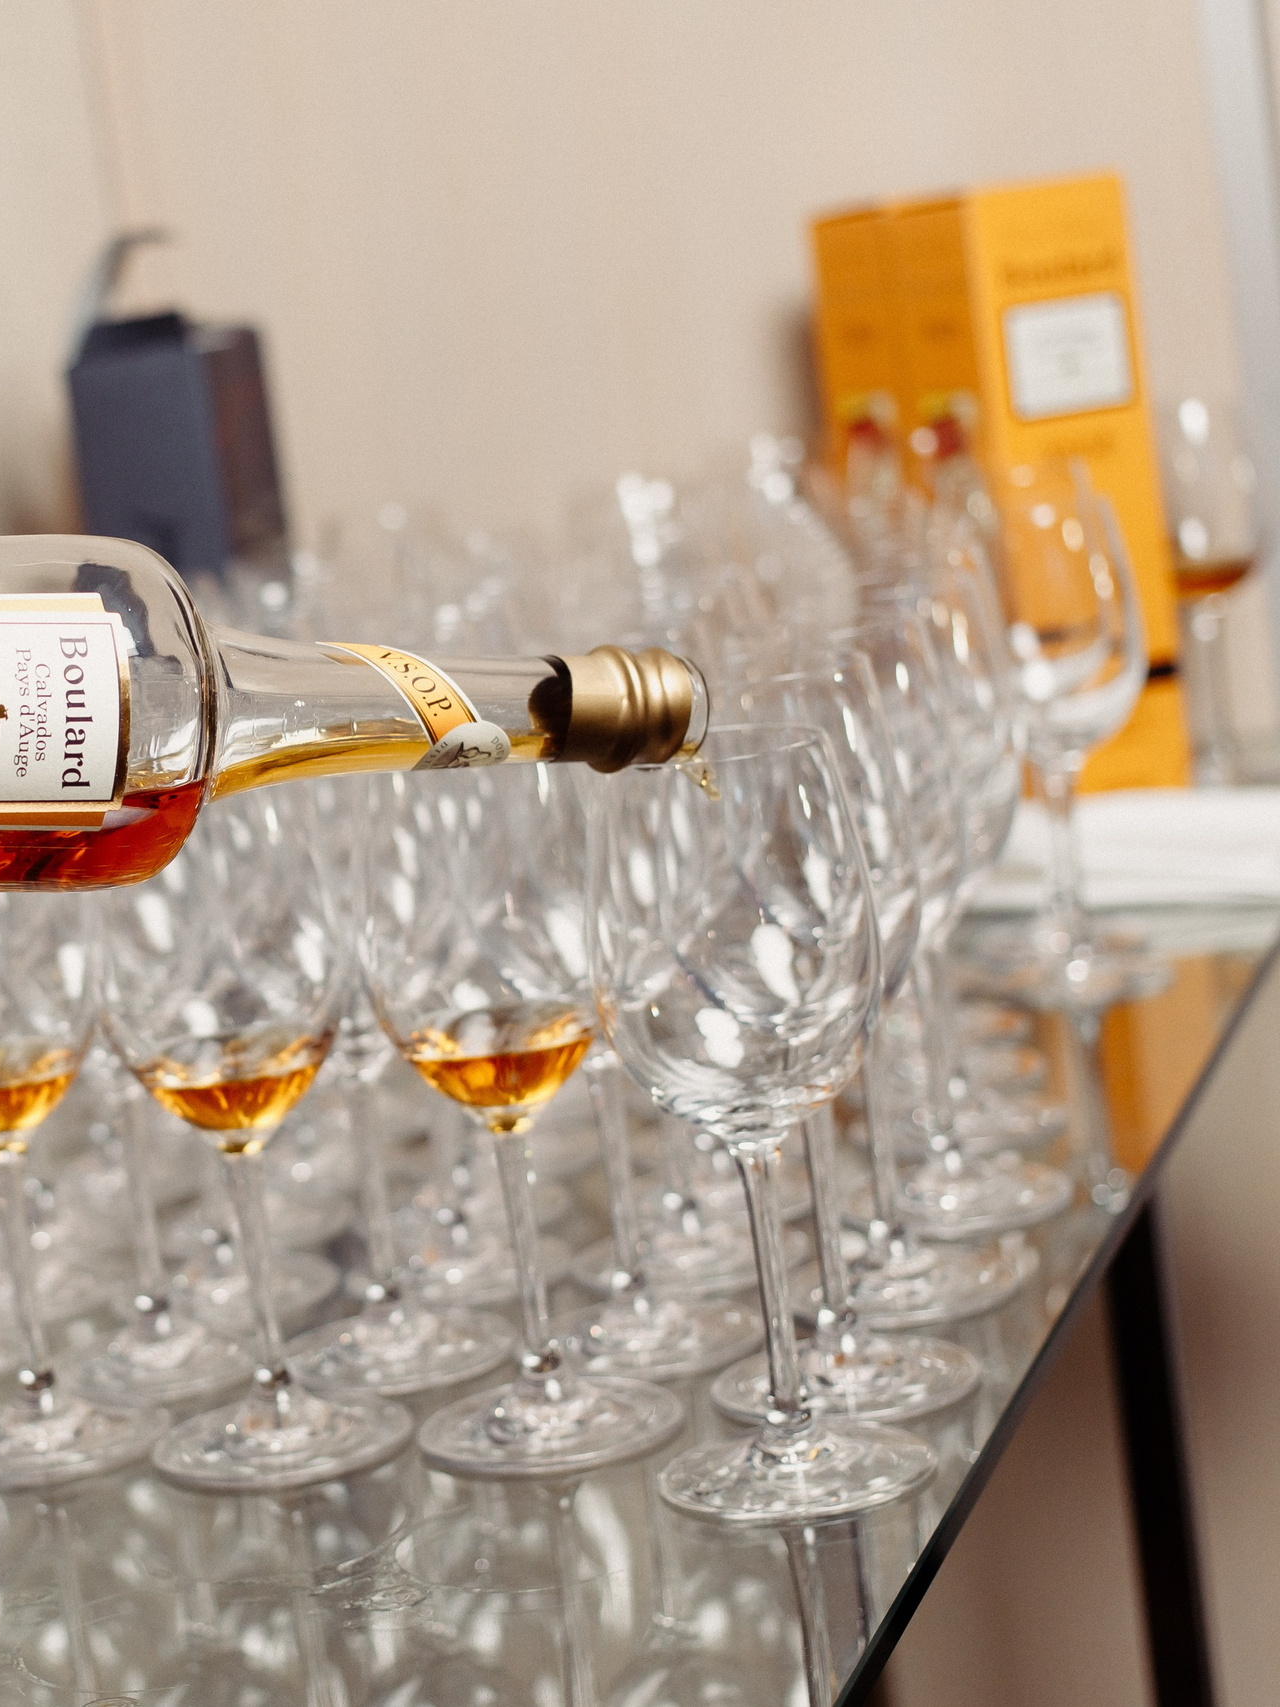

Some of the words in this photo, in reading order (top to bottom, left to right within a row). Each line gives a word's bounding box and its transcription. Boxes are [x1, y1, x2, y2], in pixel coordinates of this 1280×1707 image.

[16, 648, 32, 697] Pays
[380, 652, 452, 717] V.S.O.P.
[14, 705, 34, 778] d'Auge
[35, 663, 52, 762] Calvados
[59, 636, 93, 789] Boulard
